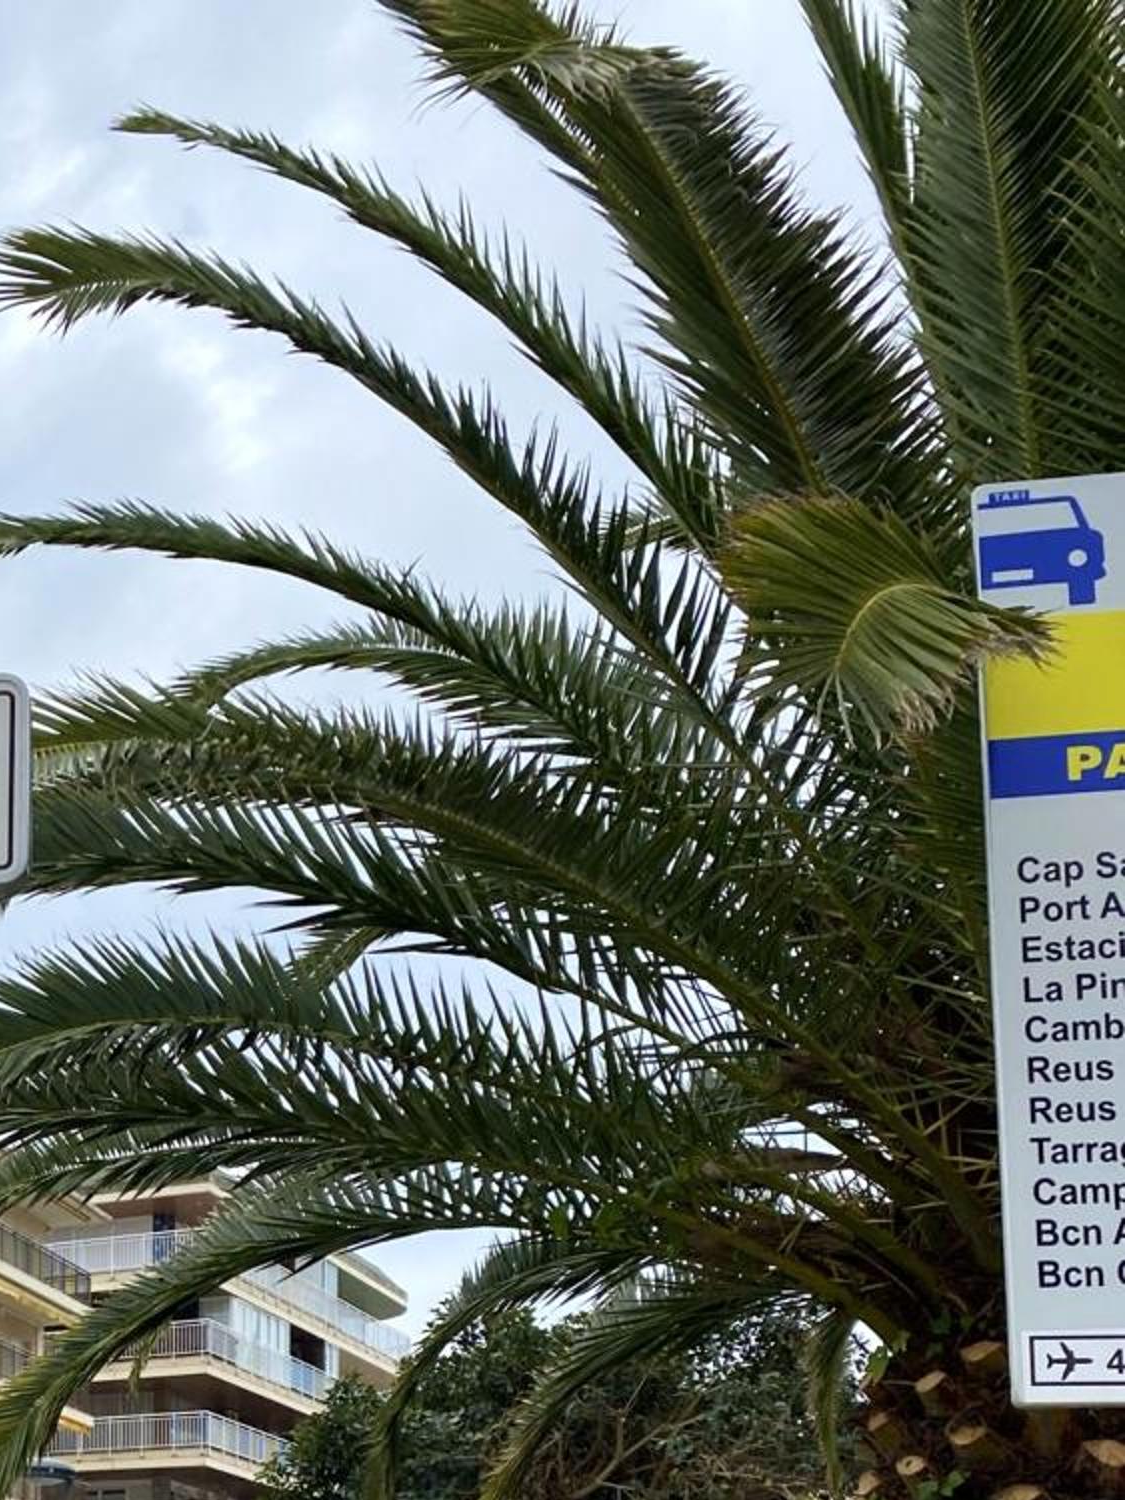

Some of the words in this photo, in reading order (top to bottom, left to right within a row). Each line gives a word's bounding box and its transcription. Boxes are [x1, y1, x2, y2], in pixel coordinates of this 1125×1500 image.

[1017, 856, 1084, 888] Cap
[1096, 851, 1125, 878] S
[1020, 895, 1091, 924] Port
[1023, 976, 1064, 1002] La
[1028, 1056, 1114, 1083] Reus
[1030, 1097, 1117, 1124] Reus
[1030, 1137, 1125, 1168] Tarra
[1036, 1219, 1102, 1246] Bcn
[1038, 1260, 1105, 1288] Bcn
